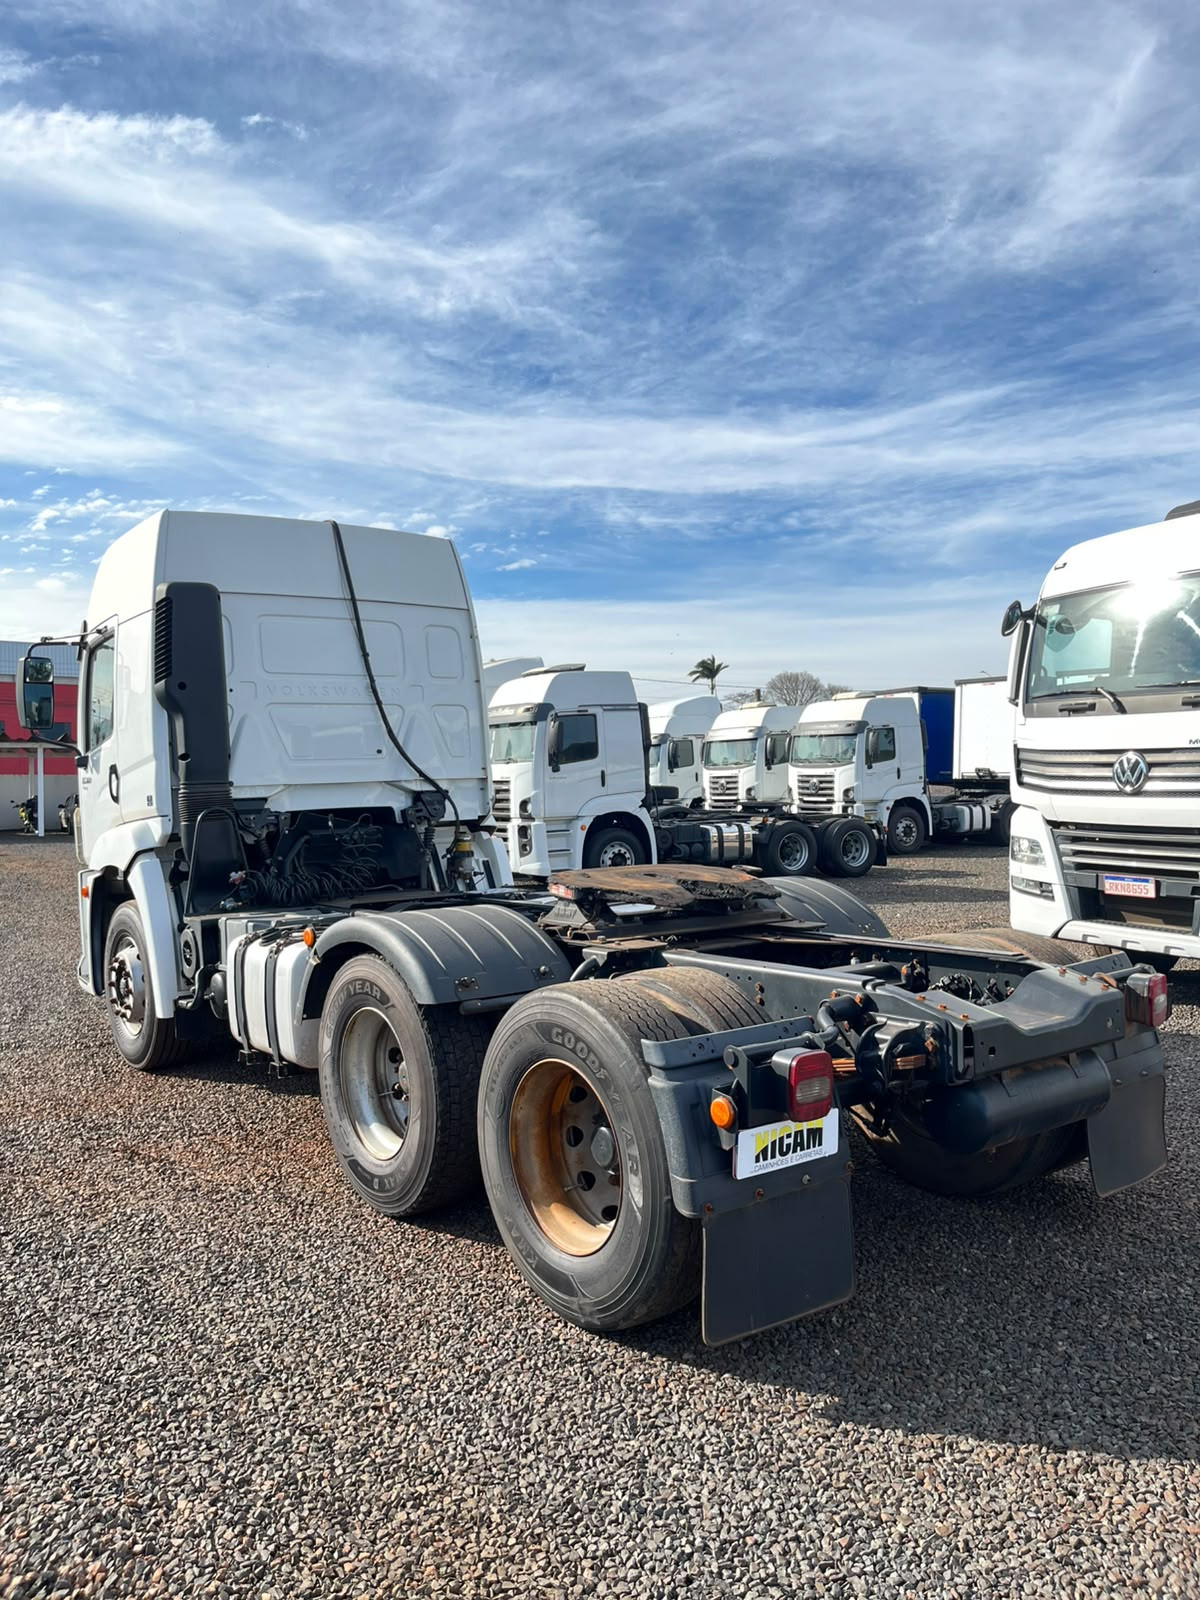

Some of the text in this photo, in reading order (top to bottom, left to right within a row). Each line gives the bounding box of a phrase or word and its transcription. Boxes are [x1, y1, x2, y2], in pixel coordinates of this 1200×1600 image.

[326, 980, 381, 1039] GOODYEAR
[551, 1026, 640, 1177] GOODYEAR
[755, 1119, 823, 1164] NICAM
[796, 1149, 823, 1161] CARRETAS
